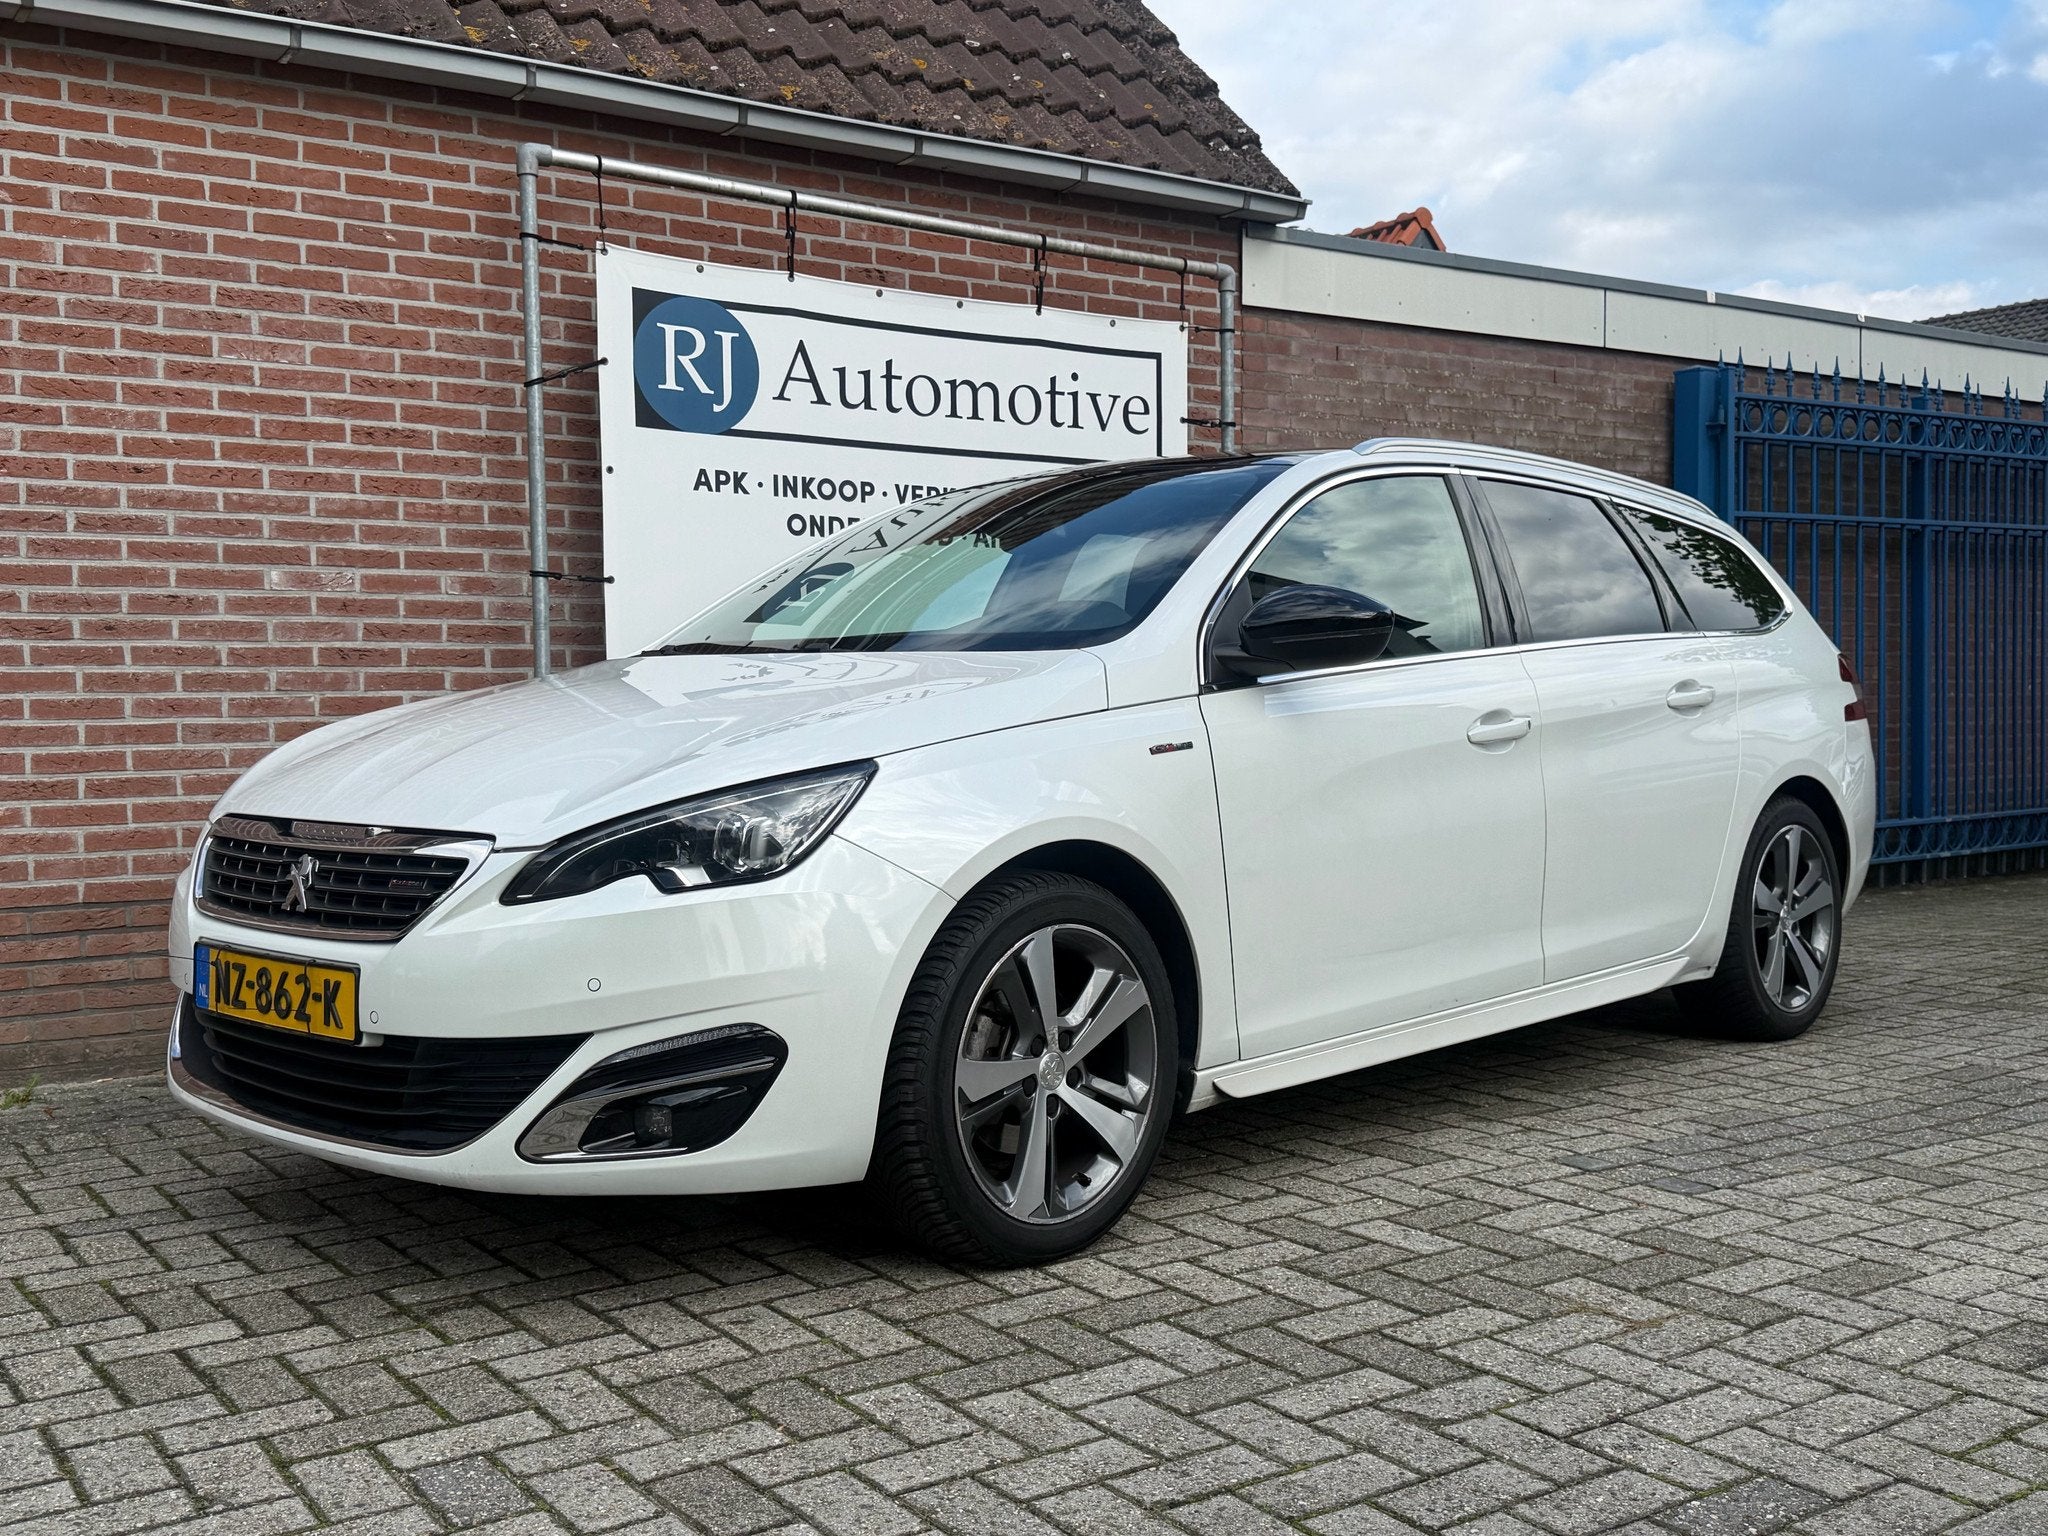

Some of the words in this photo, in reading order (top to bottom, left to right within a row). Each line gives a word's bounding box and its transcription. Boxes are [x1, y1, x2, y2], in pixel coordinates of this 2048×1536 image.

[656, 321, 740, 413] RJ
[772, 339, 1151, 435] Automotive
[692, 468, 751, 495] APK
[773, 474, 875, 503] INKOOP
[214, 958, 344, 1030] NZ-862-K
